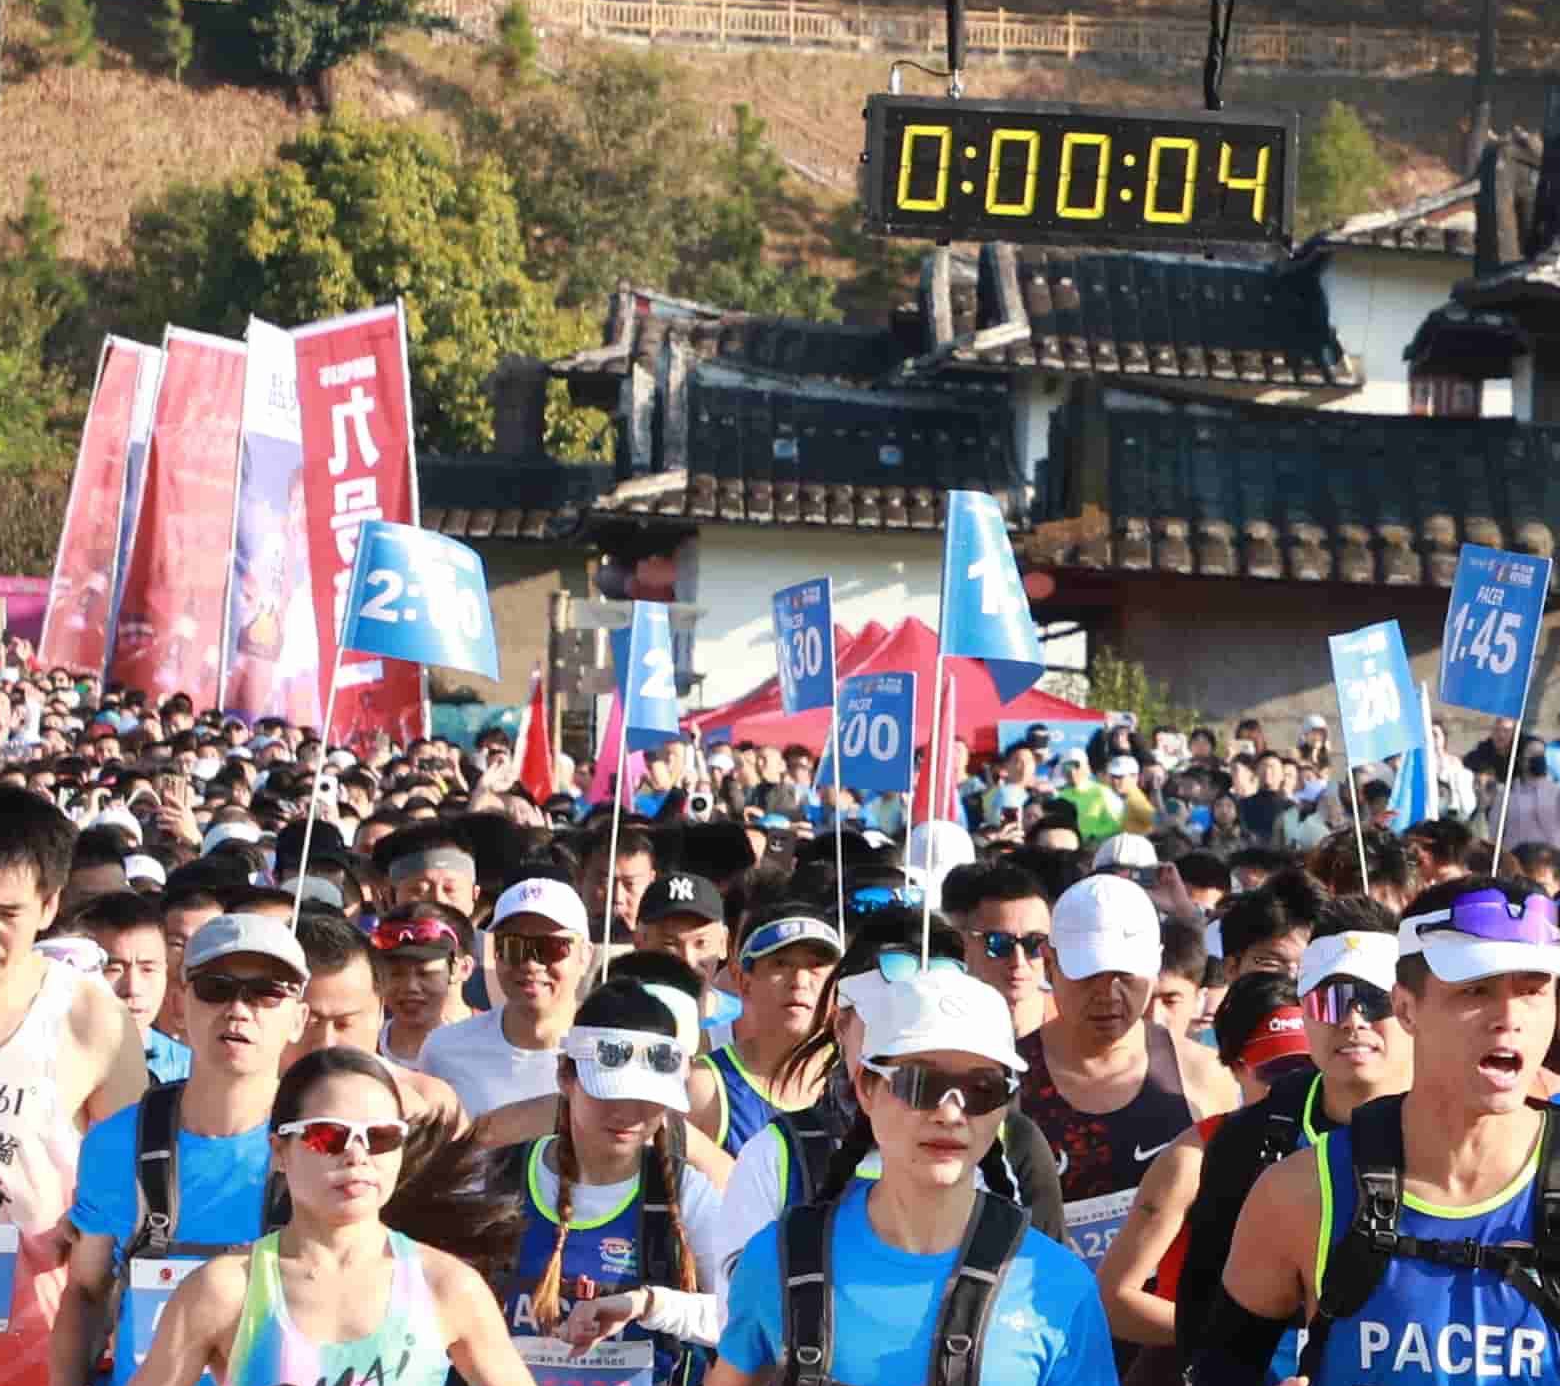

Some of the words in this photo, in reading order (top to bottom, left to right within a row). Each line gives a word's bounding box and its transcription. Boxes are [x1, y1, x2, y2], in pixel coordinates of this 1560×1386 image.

[897, 125, 1270, 224] 0:00:04
[1449, 602, 1523, 674] 1:45
[1360, 1321, 1545, 1378] PACER
